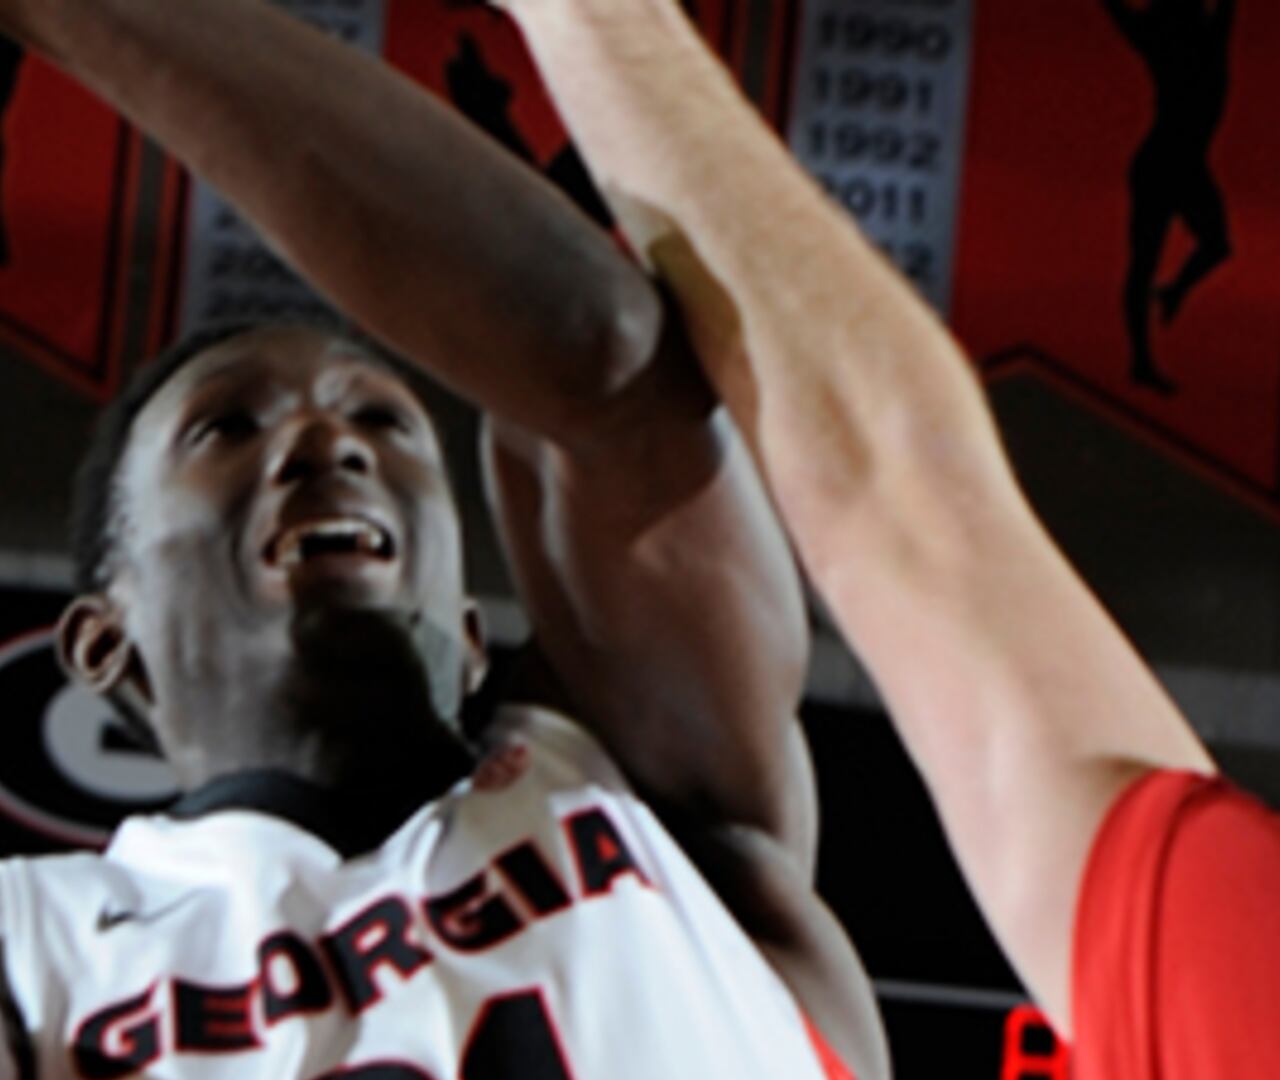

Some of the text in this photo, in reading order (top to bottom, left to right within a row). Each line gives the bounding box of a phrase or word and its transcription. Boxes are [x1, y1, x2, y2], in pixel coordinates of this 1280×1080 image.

[818, 12, 949, 62] 1990
[815, 68, 933, 113] 1991
[808, 120, 940, 173] 1992
[820, 172, 925, 222] 011
